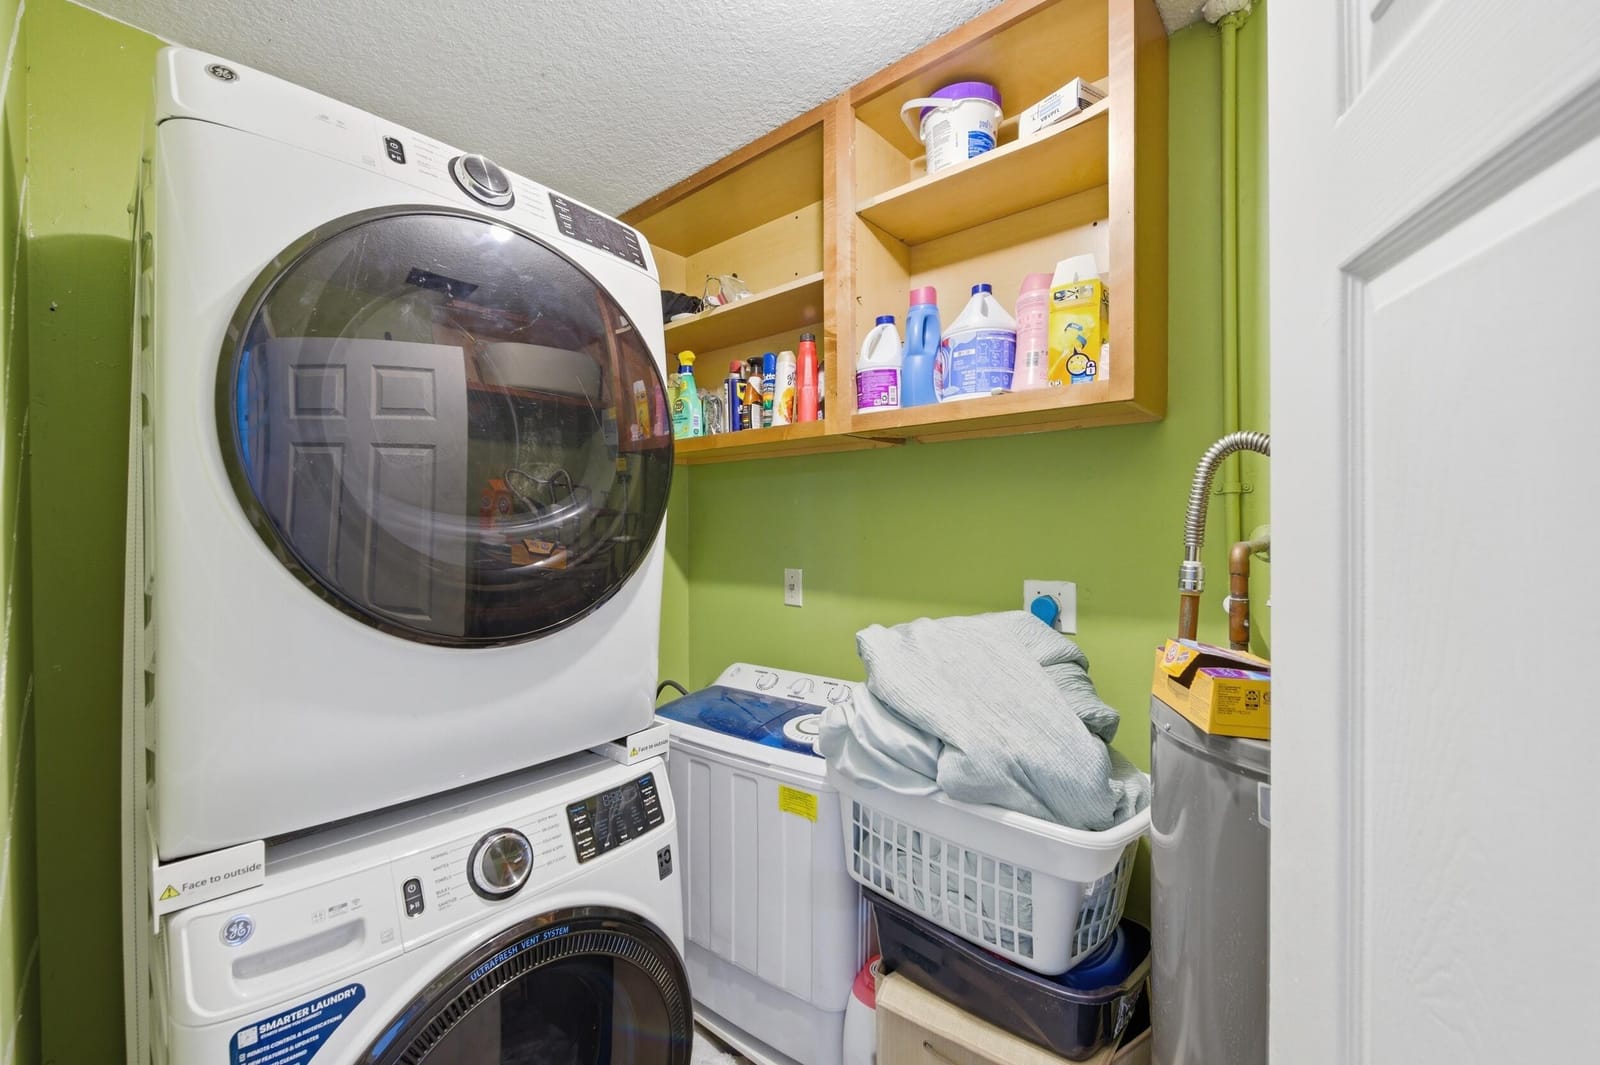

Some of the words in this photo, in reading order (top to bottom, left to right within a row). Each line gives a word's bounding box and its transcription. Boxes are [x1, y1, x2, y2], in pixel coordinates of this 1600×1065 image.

[182, 879, 207, 892] Face
[210, 874, 221, 883] to
[223, 863, 262, 880] outside
[470, 947, 518, 981] ULTRAFRESH
[521, 935, 540, 949] VENT
[543, 926, 569, 940] SYSTEM
[260, 1008, 310, 1034] SMARTER
[311, 986, 358, 1013] LAUNDRY
